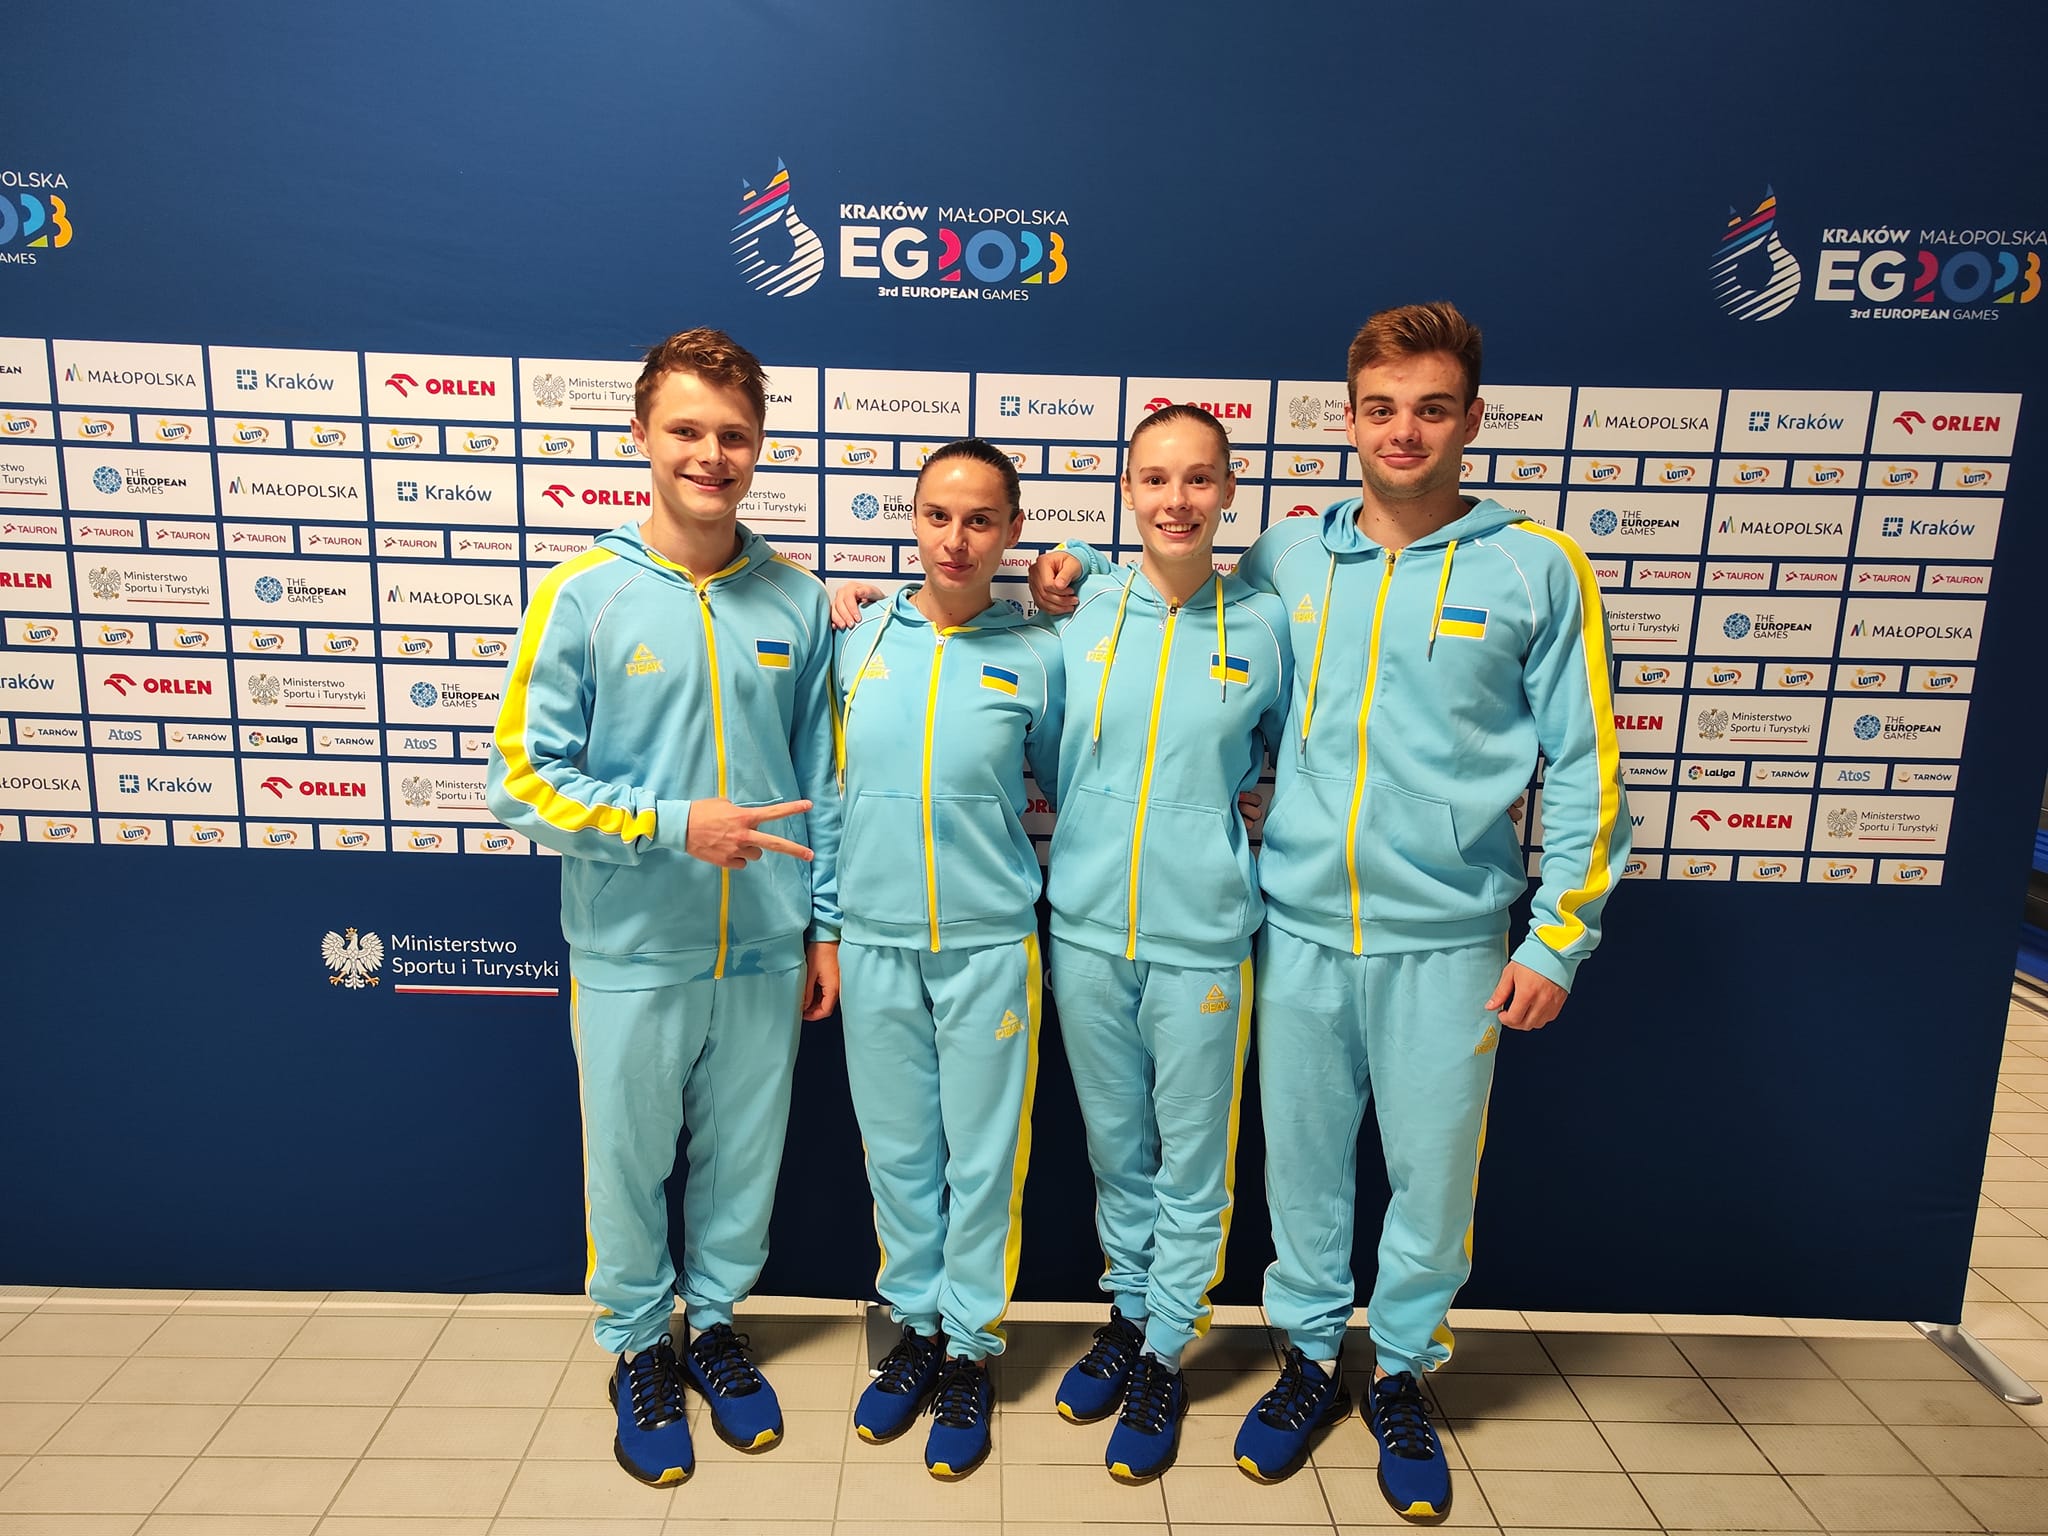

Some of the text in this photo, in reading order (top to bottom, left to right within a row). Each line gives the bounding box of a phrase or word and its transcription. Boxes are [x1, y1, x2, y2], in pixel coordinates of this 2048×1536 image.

[841, 201, 1069, 225] KRAKÓW MAŁOPOLSKA
[1822, 225, 2047, 245] KRAKÓW MAŁOPOLSKA
[878, 286, 1028, 301] 3rd EUROPEAN GAMES
[1850, 308, 1999, 320] 3rd EUROPEAN GAMES
[88, 370, 196, 386] MAŁOPOLSKA
[266, 373, 334, 390] Kraków
[569, 378, 632, 388] Ministerstwo
[426, 379, 495, 396] ORLEN
[569, 390, 601, 401] Sportu
[857, 399, 960, 414] MAŁOPOLSKA
[1029, 399, 1094, 415] Kraków
[1486, 404, 1504, 412] THE
[1485, 413, 1543, 421] EUROPEAN
[1777, 413, 1844, 429] Kraków
[8, 421, 30, 431] LOTTO
[85, 423, 108, 434] LOTTO
[1484, 421, 1519, 429] GAMES
[1605, 416, 1708, 430] MAŁOPOLSKA
[1932, 415, 2000, 431] ORLEN
[162, 425, 185, 437] LOTTO
[239, 429, 263, 440] LOTTO
[317, 432, 340, 444] LOTTO
[393, 435, 416, 447] LOTTO
[469, 438, 492, 449] LOTTO
[546, 441, 568, 452] LOTTO
[773, 448, 795, 459] LOTTO
[848, 450, 871, 462] LOTTO
[1072, 458, 1094, 469] LOTTO
[1295, 462, 1317, 473] LOTTO
[125, 468, 145, 477] THE
[1518, 466, 1541, 477] LOTTO
[1592, 467, 1615, 478] LOTTO
[1666, 469, 1688, 480] LOTTO
[1741, 470, 1763, 482] LOTTO
[1816, 471, 1838, 482] LOTTO
[2, 474, 47, 486] Turystyki
[126, 477, 186, 486] EUROPEAN
[1889, 472, 1912, 483] LOTTO
[1963, 473, 1986, 484] LOTTO
[126, 486, 164, 495] GAMES
[252, 483, 358, 498] MAŁOPOLSKA
[426, 485, 492, 501] Kraków
[582, 489, 651, 506] ORLEN
[883, 495, 902, 503] THE
[763, 502, 806, 513] Turystyki
[1623, 510, 1641, 518] THE
[1621, 519, 1679, 527] EUROPEAN
[1741, 522, 1843, 535] MAŁOPOLSKA
[1910, 520, 1975, 535] Kraków
[17, 526, 57, 534] TAURON
[93, 529, 133, 537] TAURON
[170, 531, 210, 540] TAURON
[1621, 527, 1655, 535] GAMES
[247, 534, 286, 543] TAURON
[323, 537, 362, 545] TAURON
[398, 540, 437, 548] TAURON
[473, 542, 512, 550] TAURON
[548, 544, 587, 552] TAURON
[847, 554, 885, 562] TAURON
[124, 571, 187, 582] Ministerstwo
[1653, 571, 1691, 579] TAURON
[1726, 572, 1764, 580] TAURON
[1800, 573, 1837, 581] TAURON
[1946, 576, 1983, 584] TAURON
[286, 578, 306, 586] THE
[125, 583, 158, 596] Sportu
[165, 584, 209, 595] Turystyki
[287, 587, 346, 595] EUROPEAN
[288, 595, 323, 603] GAMES
[410, 592, 513, 606] MAŁOPOLSKA
[1756, 614, 1775, 622] THE
[1638, 623, 1679, 633] Turystyki
[1755, 623, 1812, 631] EUROPEAN
[1872, 626, 1972, 639] MAŁOPOLSKA
[29, 629, 51, 640] LOTTO
[105, 631, 127, 643] LOTTO
[180, 634, 203, 645] LOTTO
[1754, 631, 1788, 639] GAMES
[255, 637, 278, 648] LOTTO
[330, 639, 352, 650] LOTTO
[404, 641, 426, 652] LOTTO
[478, 644, 501, 655] LOTTO
[1641, 671, 1664, 682] LOTTO
[1713, 672, 1736, 683] LOTTO
[1785, 673, 1808, 684] LOTTO
[1857, 675, 1880, 685] LOTTO
[1929, 676, 1952, 687] LOTTO
[143, 678, 212, 695] ORLEN
[283, 678, 345, 687] Ministerstwo
[441, 683, 460, 691] THE
[283, 689, 315, 702] Sportu
[323, 690, 365, 701] Turystyki
[442, 692, 499, 700] EUROPEAN
[441, 700, 478, 708] GAMES
[1732, 712, 1792, 721] Ministerstwo
[1885, 715, 1904, 724] THE
[38, 728, 77, 736] TARNÓW
[1730, 723, 1761, 733] Sportu
[1769, 724, 1810, 734] Turystyki
[1885, 724, 1941, 732] EUROPEAN
[187, 733, 227, 741] TARNÓW
[266, 735, 298, 745] LaLiga
[1883, 732, 1917, 740] GAMES
[1705, 769, 1735, 778] LaLiga
[1771, 770, 1809, 778] TARNÓW
[147, 777, 212, 793] Kraków
[299, 781, 366, 797] ORLEN
[436, 791, 466, 800] Sportu
[1727, 814, 1792, 829] ORLEN
[1861, 812, 1920, 820] Ministerstwo
[49, 826, 71, 838] LOTTO
[1859, 822, 1889, 832] Sportu
[1898, 823, 1938, 833] Turystyki
[122, 828, 145, 839] LOTTO
[196, 831, 218, 842] LOTTO
[269, 833, 292, 844] LOTTO
[342, 834, 364, 845] LOTTO
[414, 836, 437, 847] LOTTO
[486, 838, 508, 849] LOTTO
[1689, 864, 1711, 875] LOTTO
[1759, 866, 1781, 876] LOTTO
[1829, 868, 1851, 878] LOTTO
[1900, 869, 1922, 880] LOTTO
[392, 935, 516, 953] Ministerstwo
[393, 957, 455, 976] Sportu
[472, 959, 558, 979] Turystyki
